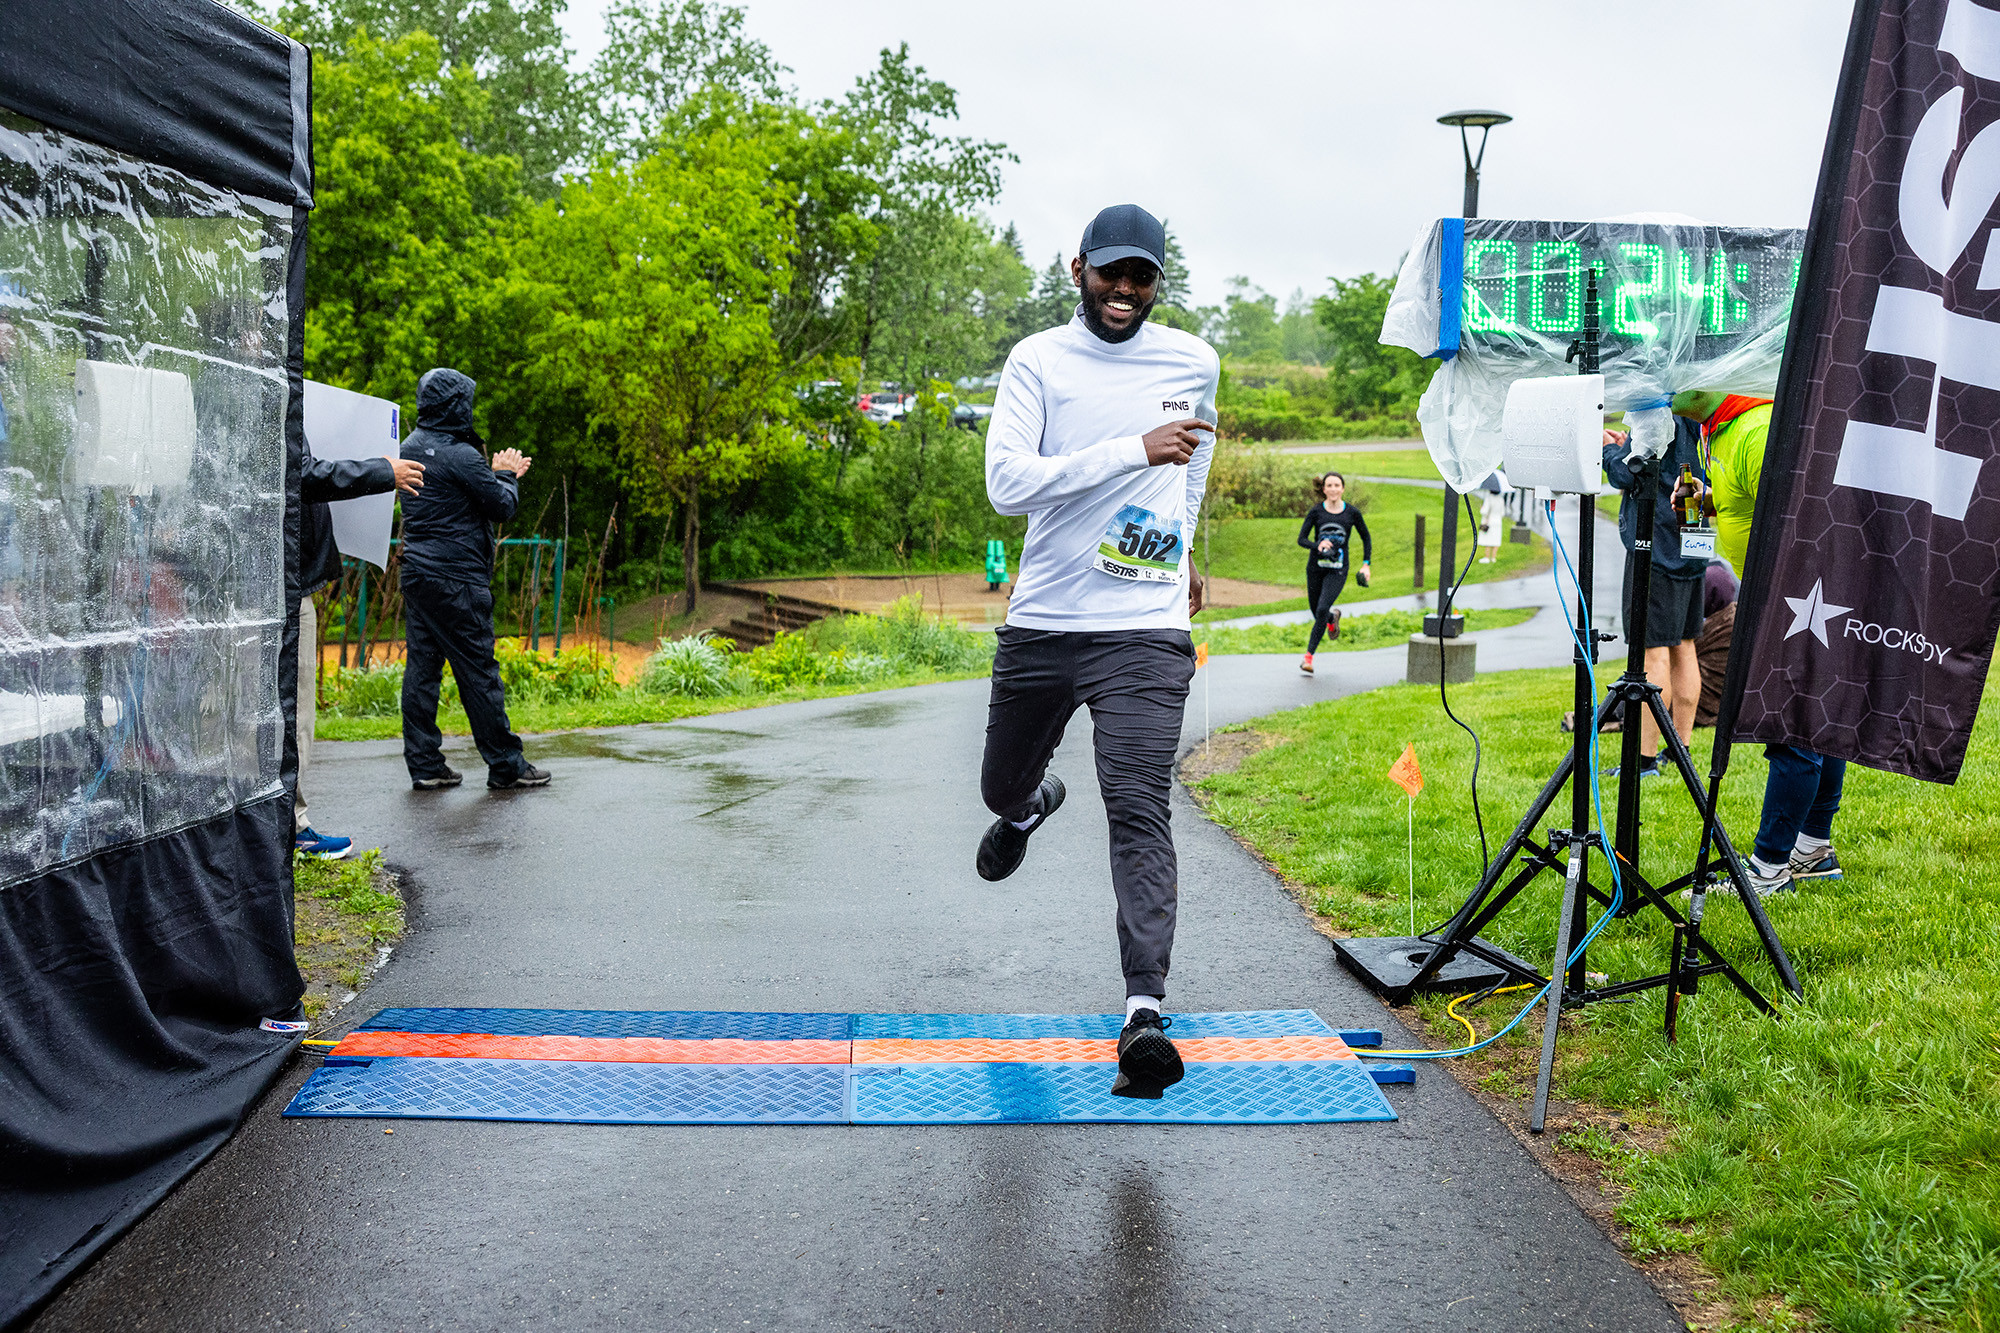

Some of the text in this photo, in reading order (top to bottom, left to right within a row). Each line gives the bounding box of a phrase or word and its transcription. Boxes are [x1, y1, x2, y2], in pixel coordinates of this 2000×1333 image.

[1162, 401, 1190, 411] PING
[1118, 522, 1178, 562] 562
[1684, 539, 1712, 551] Curtis
